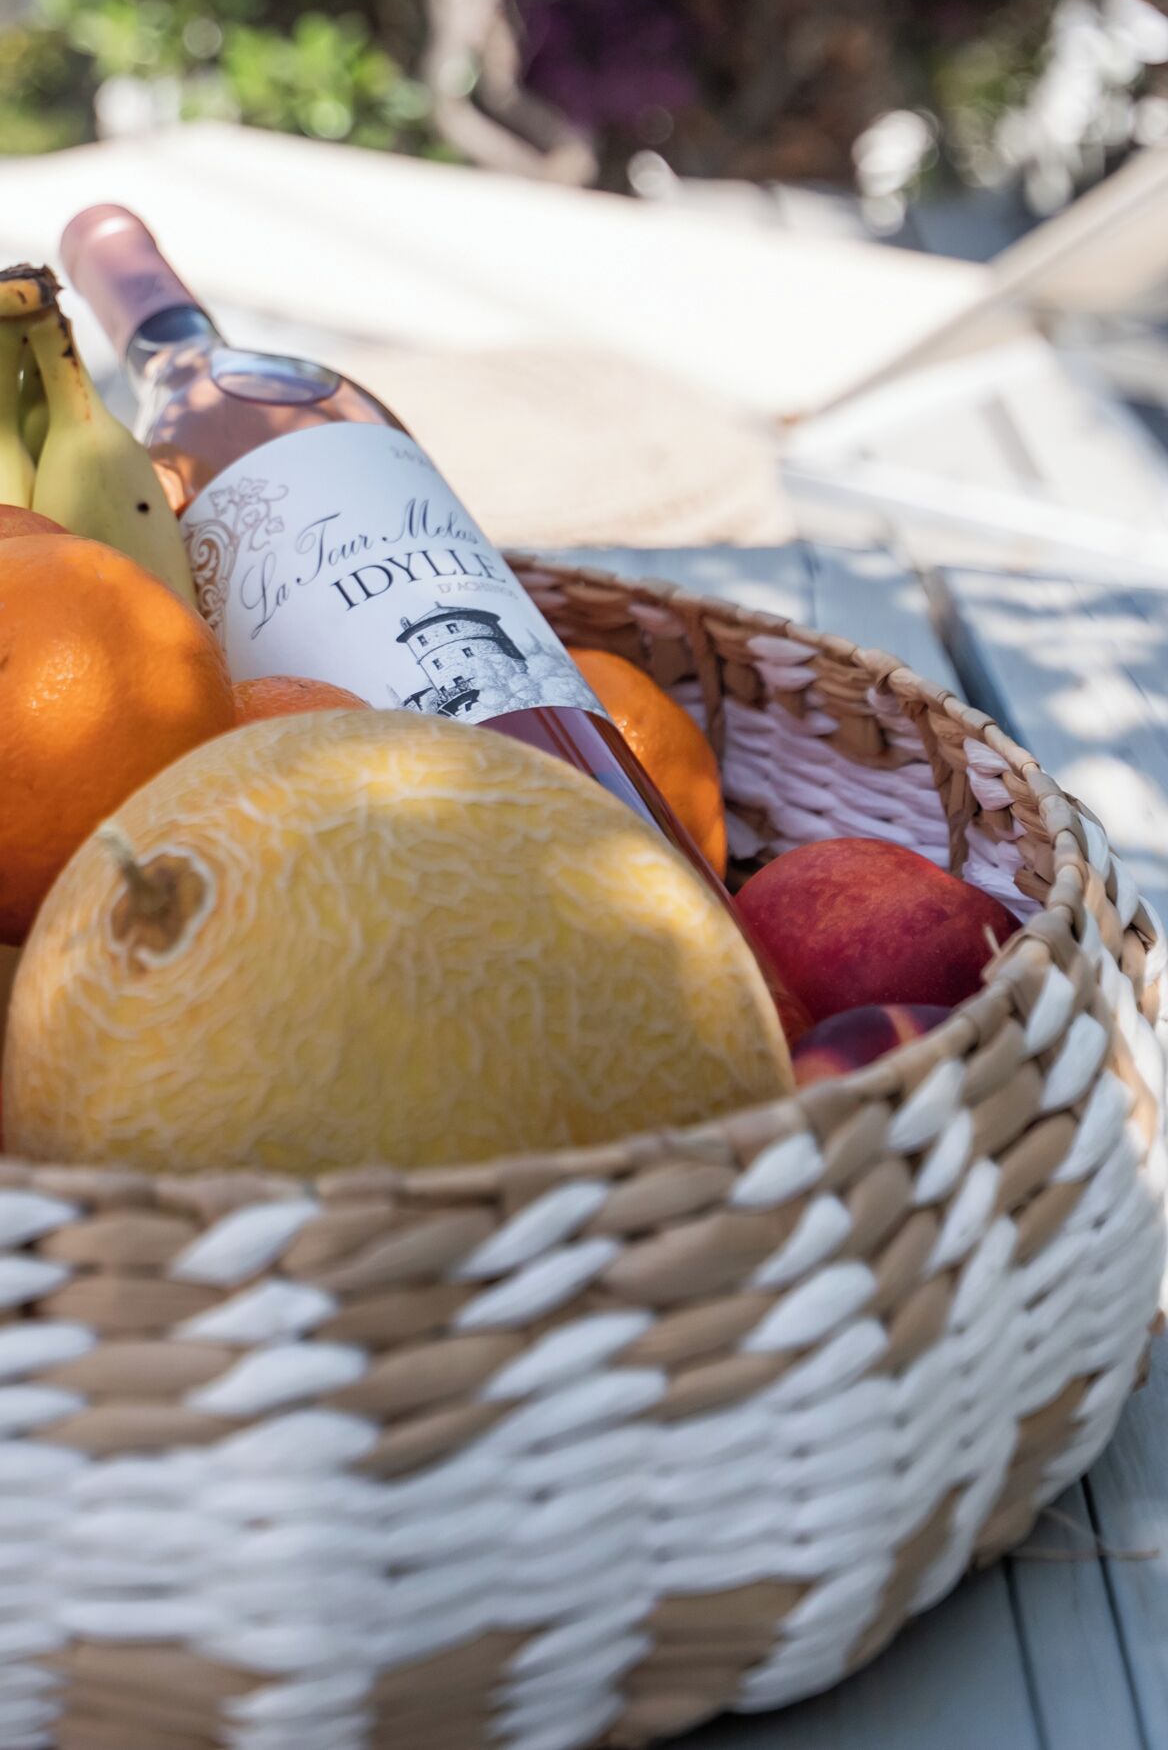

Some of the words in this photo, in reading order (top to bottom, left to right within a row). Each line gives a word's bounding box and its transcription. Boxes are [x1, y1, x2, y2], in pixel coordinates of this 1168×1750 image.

[241, 553, 289, 640] La
[296, 513, 374, 586] Tour
[332, 549, 507, 611] IDYLLE
